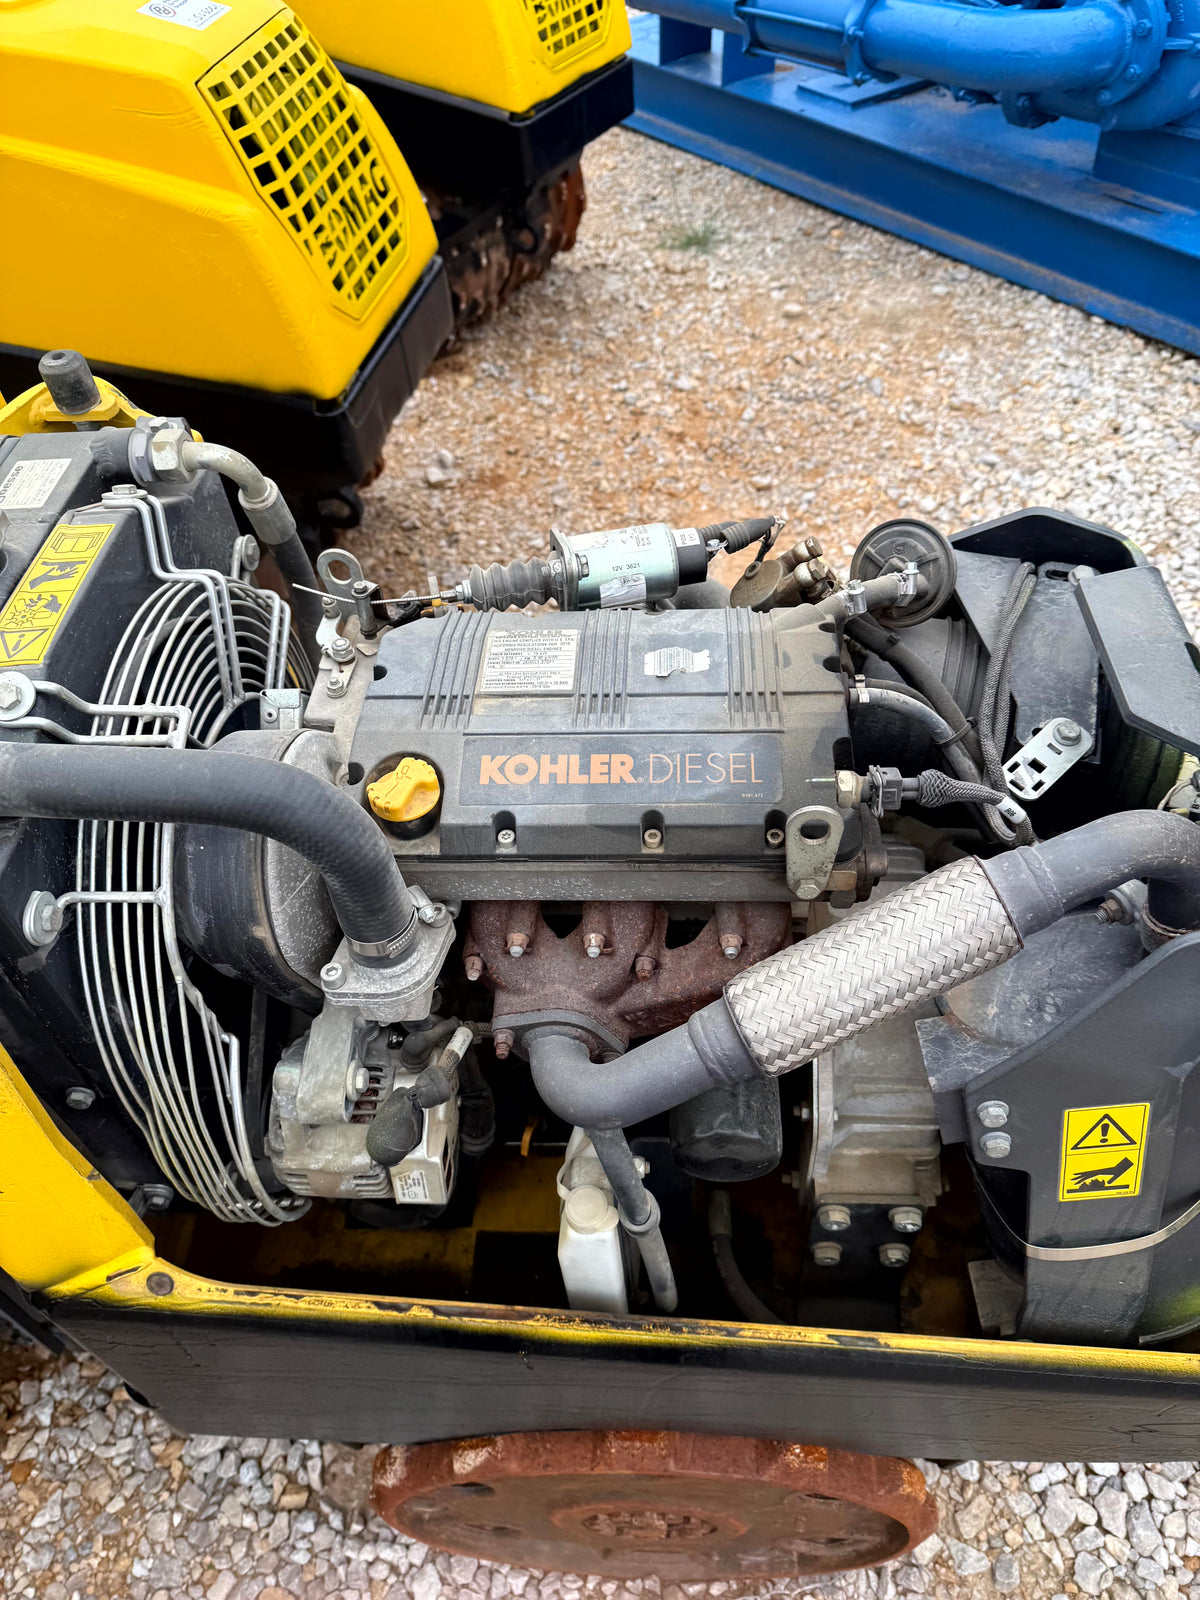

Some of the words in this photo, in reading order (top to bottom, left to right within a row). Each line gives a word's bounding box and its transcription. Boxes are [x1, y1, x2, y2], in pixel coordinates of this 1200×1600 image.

[313, 158, 390, 269] BOMAG
[479, 754, 637, 785] KOHLER
[649, 753, 764, 784] DIESEL
